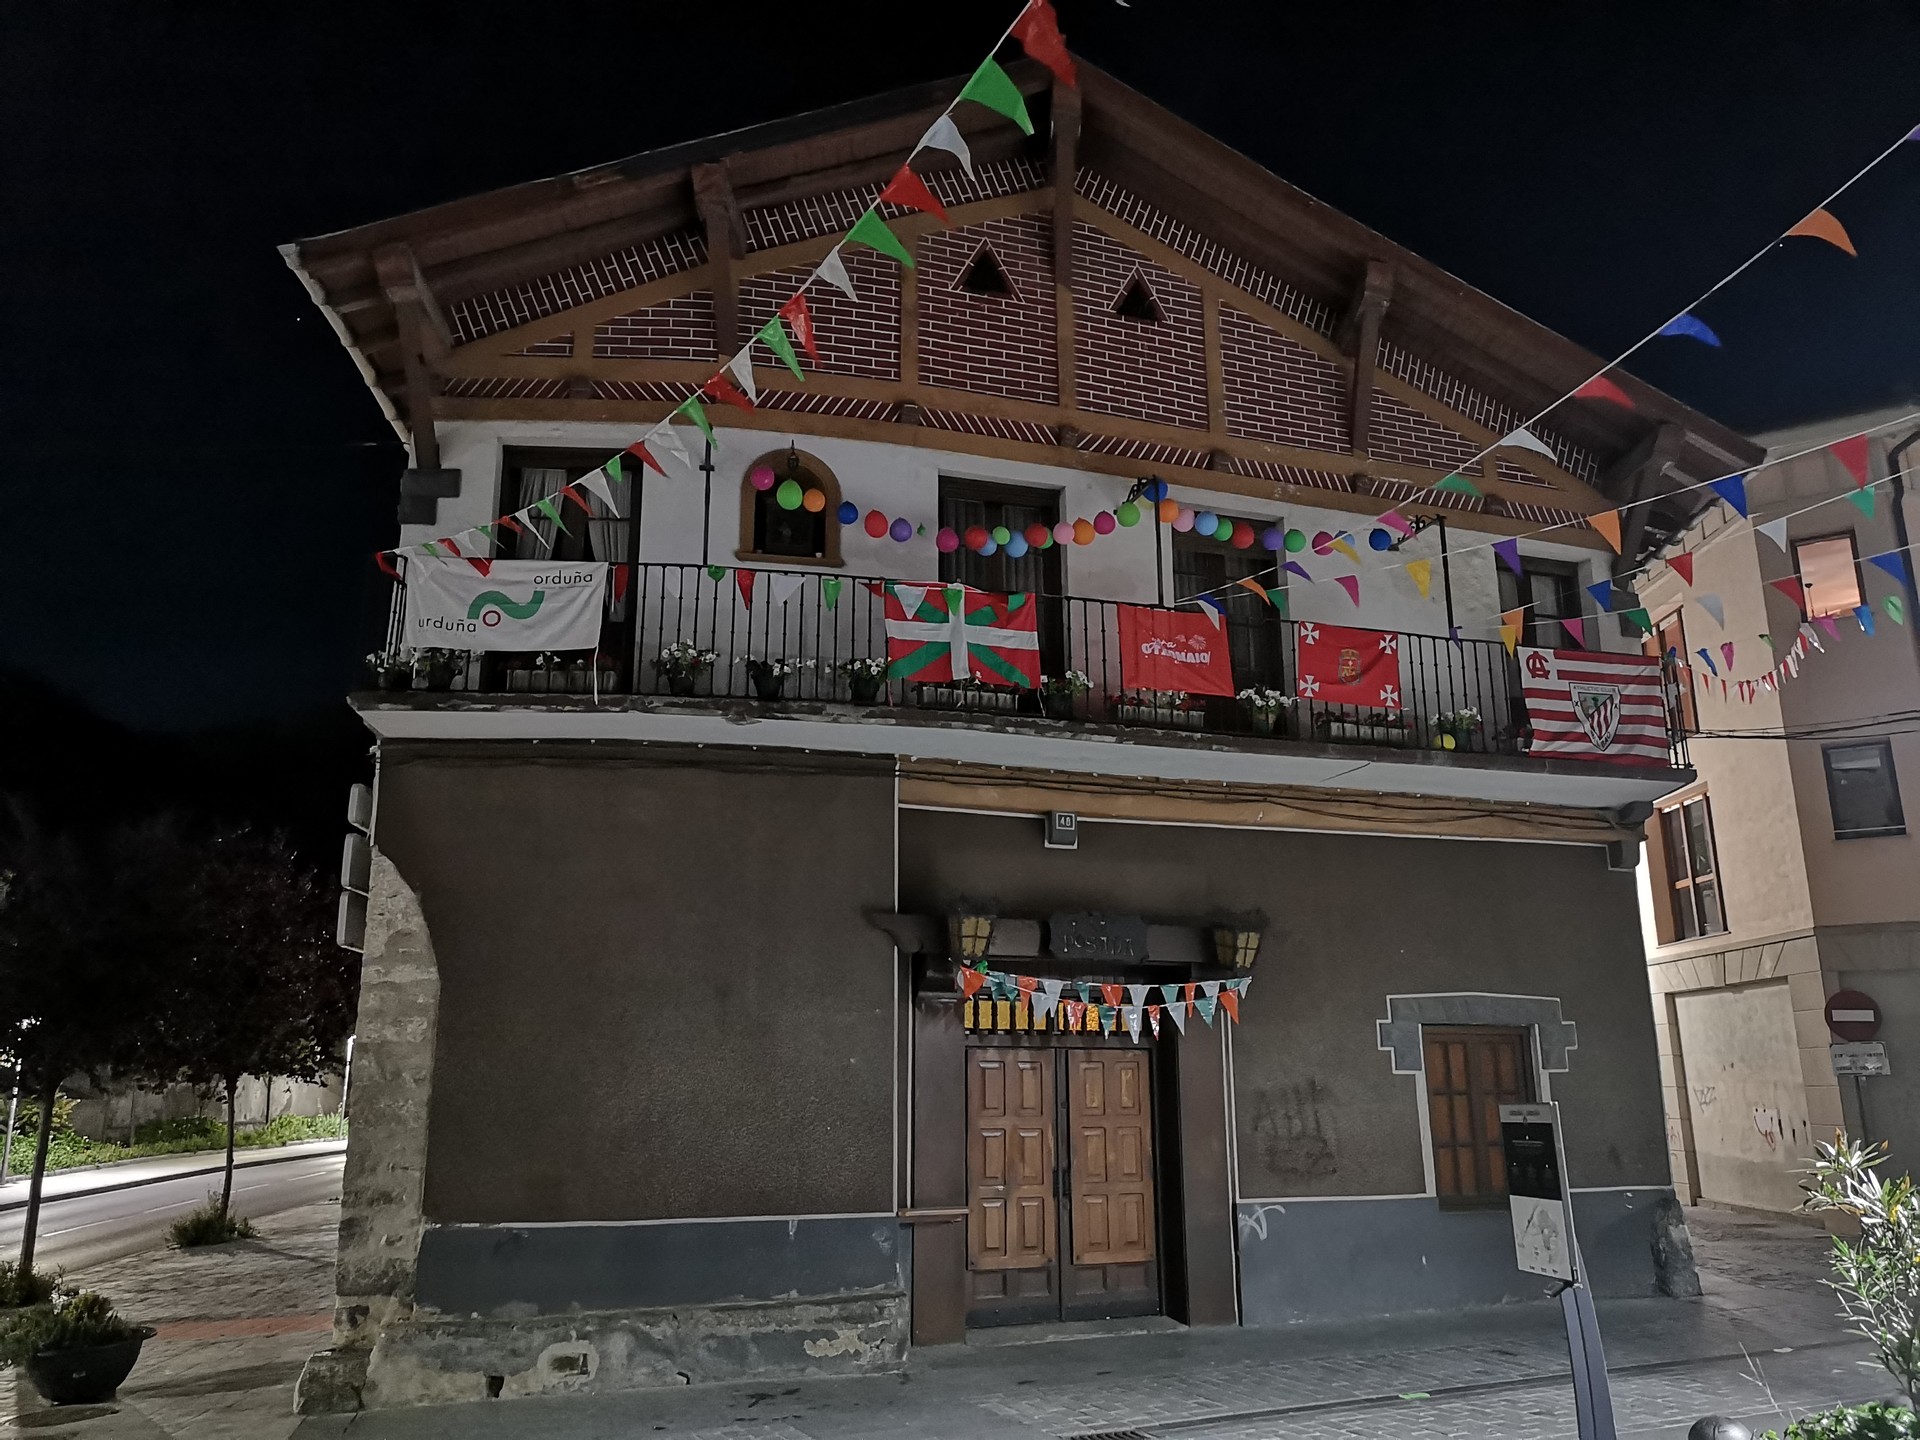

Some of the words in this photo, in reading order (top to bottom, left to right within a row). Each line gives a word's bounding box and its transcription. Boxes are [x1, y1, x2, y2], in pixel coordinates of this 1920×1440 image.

[533, 569, 593, 585] orduña
[417, 616, 477, 633] urduña
[1060, 816, 1071, 827] 40
